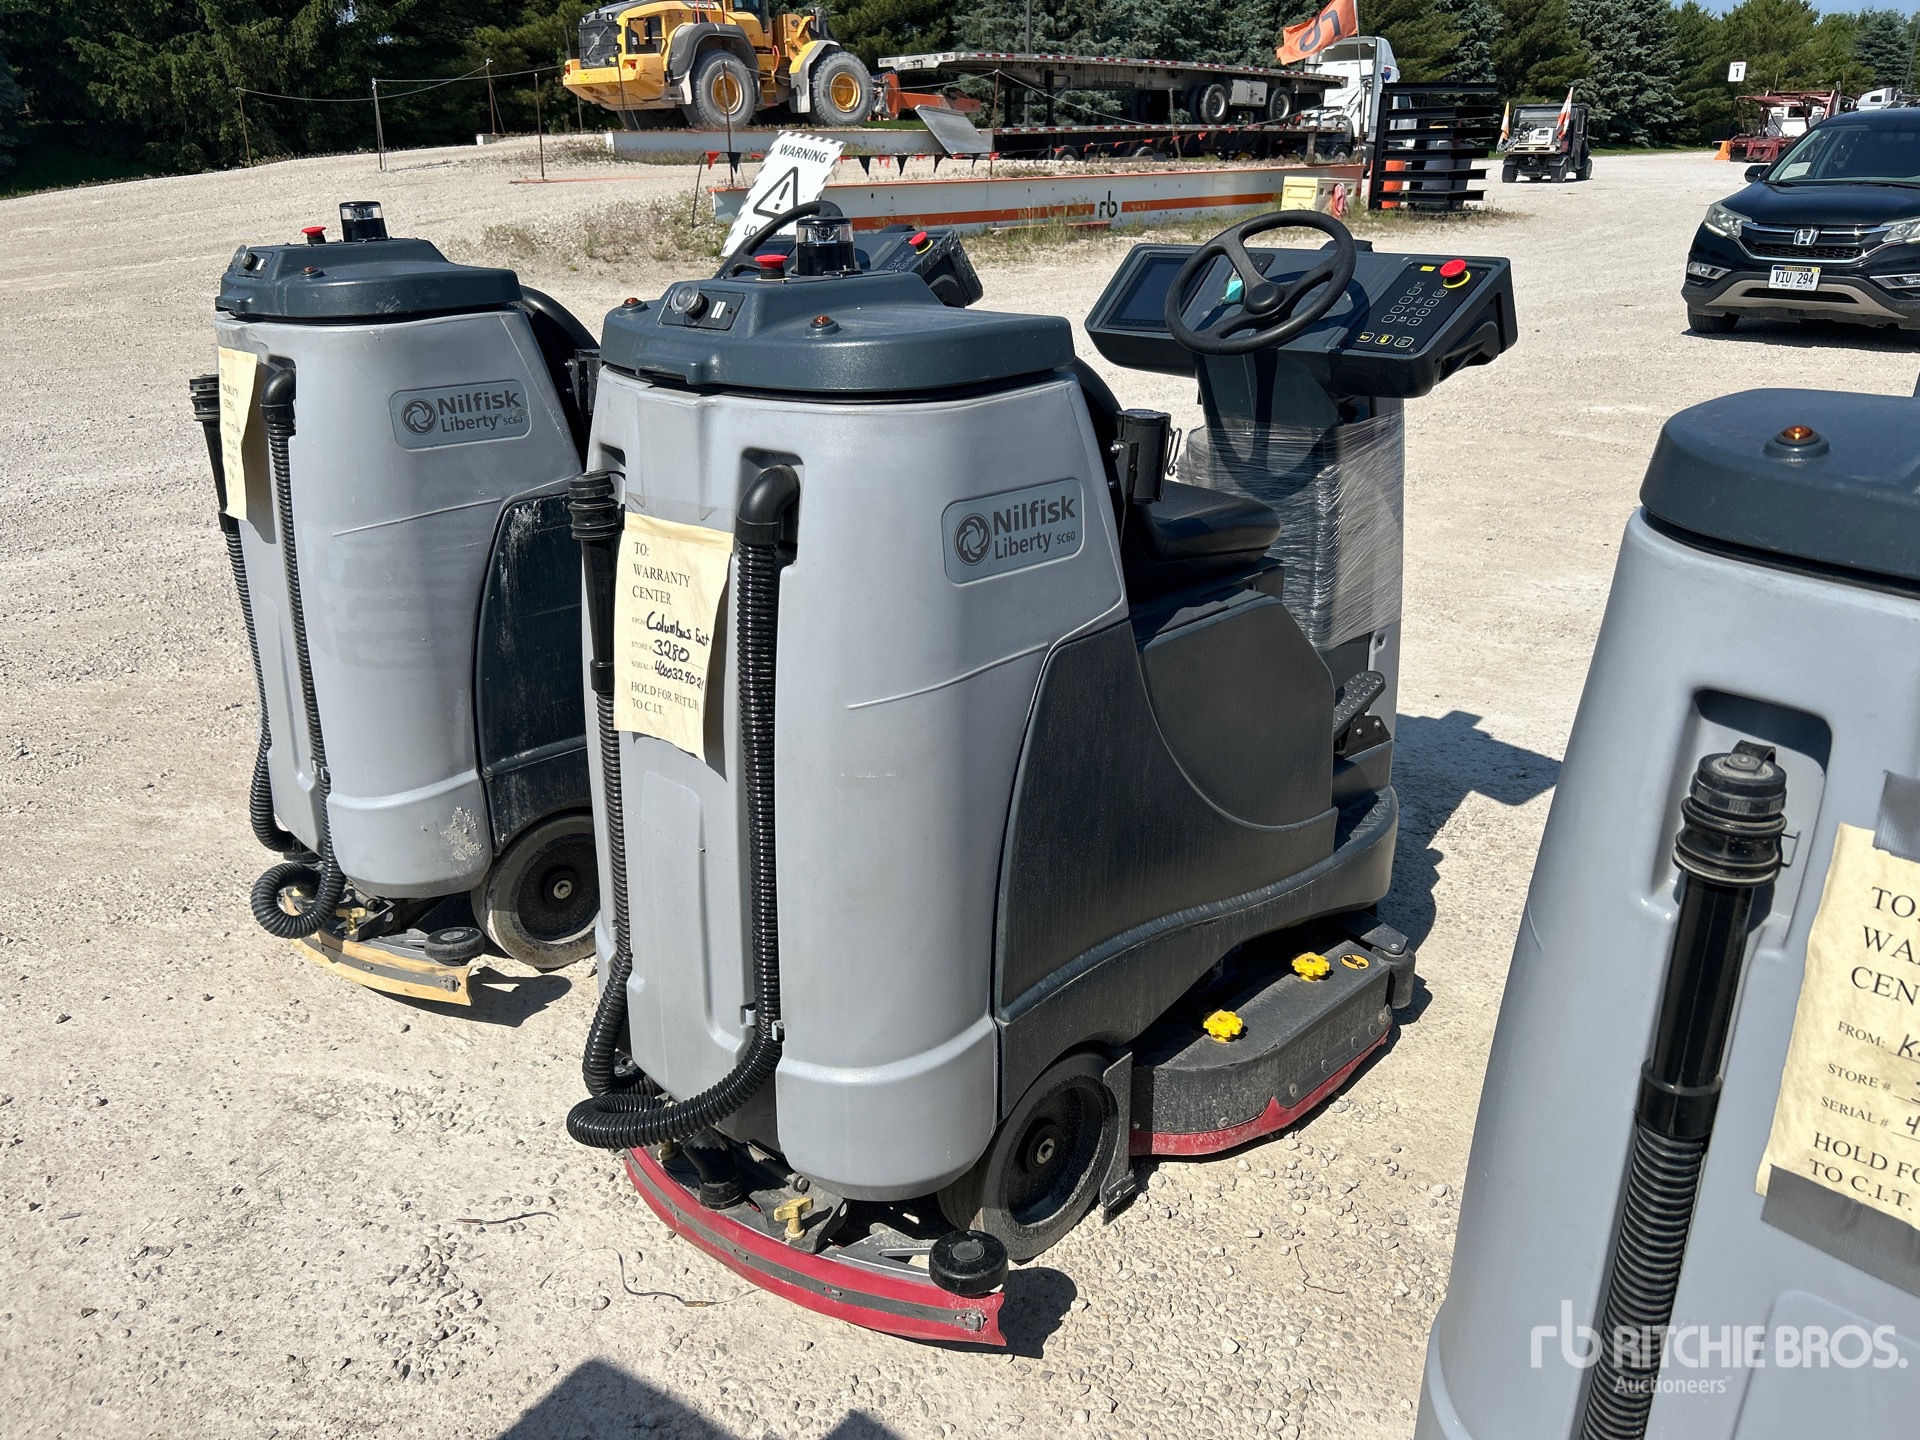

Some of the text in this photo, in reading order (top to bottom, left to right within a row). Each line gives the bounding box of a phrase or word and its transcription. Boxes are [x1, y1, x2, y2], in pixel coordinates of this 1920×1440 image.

[1735, 67, 1739, 77] 1
[780, 144, 828, 163] WARNING
[1099, 190, 1118, 218] rb
[1775, 271, 1792, 284] VIU
[1797, 272, 1814, 285] 294
[437, 390, 521, 416] Nilfisk
[440, 414, 497, 433] Liberty
[993, 496, 1076, 536] Nilfisk
[634, 542, 649, 557] TO:
[994, 531, 1076, 560] Liberty SC60
[633, 563, 690, 587] WARRANTY
[632, 585, 671, 605] CENTER
[631, 616, 647, 626] FROM
[631, 641, 648, 651] STORE
[653, 639, 690, 662] 3280
[631, 681, 656, 696] HOLD
[657, 688, 673, 702] FOR
[631, 697, 643, 710] TO
[1838, 1020, 1885, 1048] FROM:
[1828, 1063, 1879, 1088] STORE
[1821, 1096, 1876, 1124] SERIAL
[1813, 1131, 1888, 1172] HOLD
[1809, 1158, 1913, 1212] TO C.I.T.
